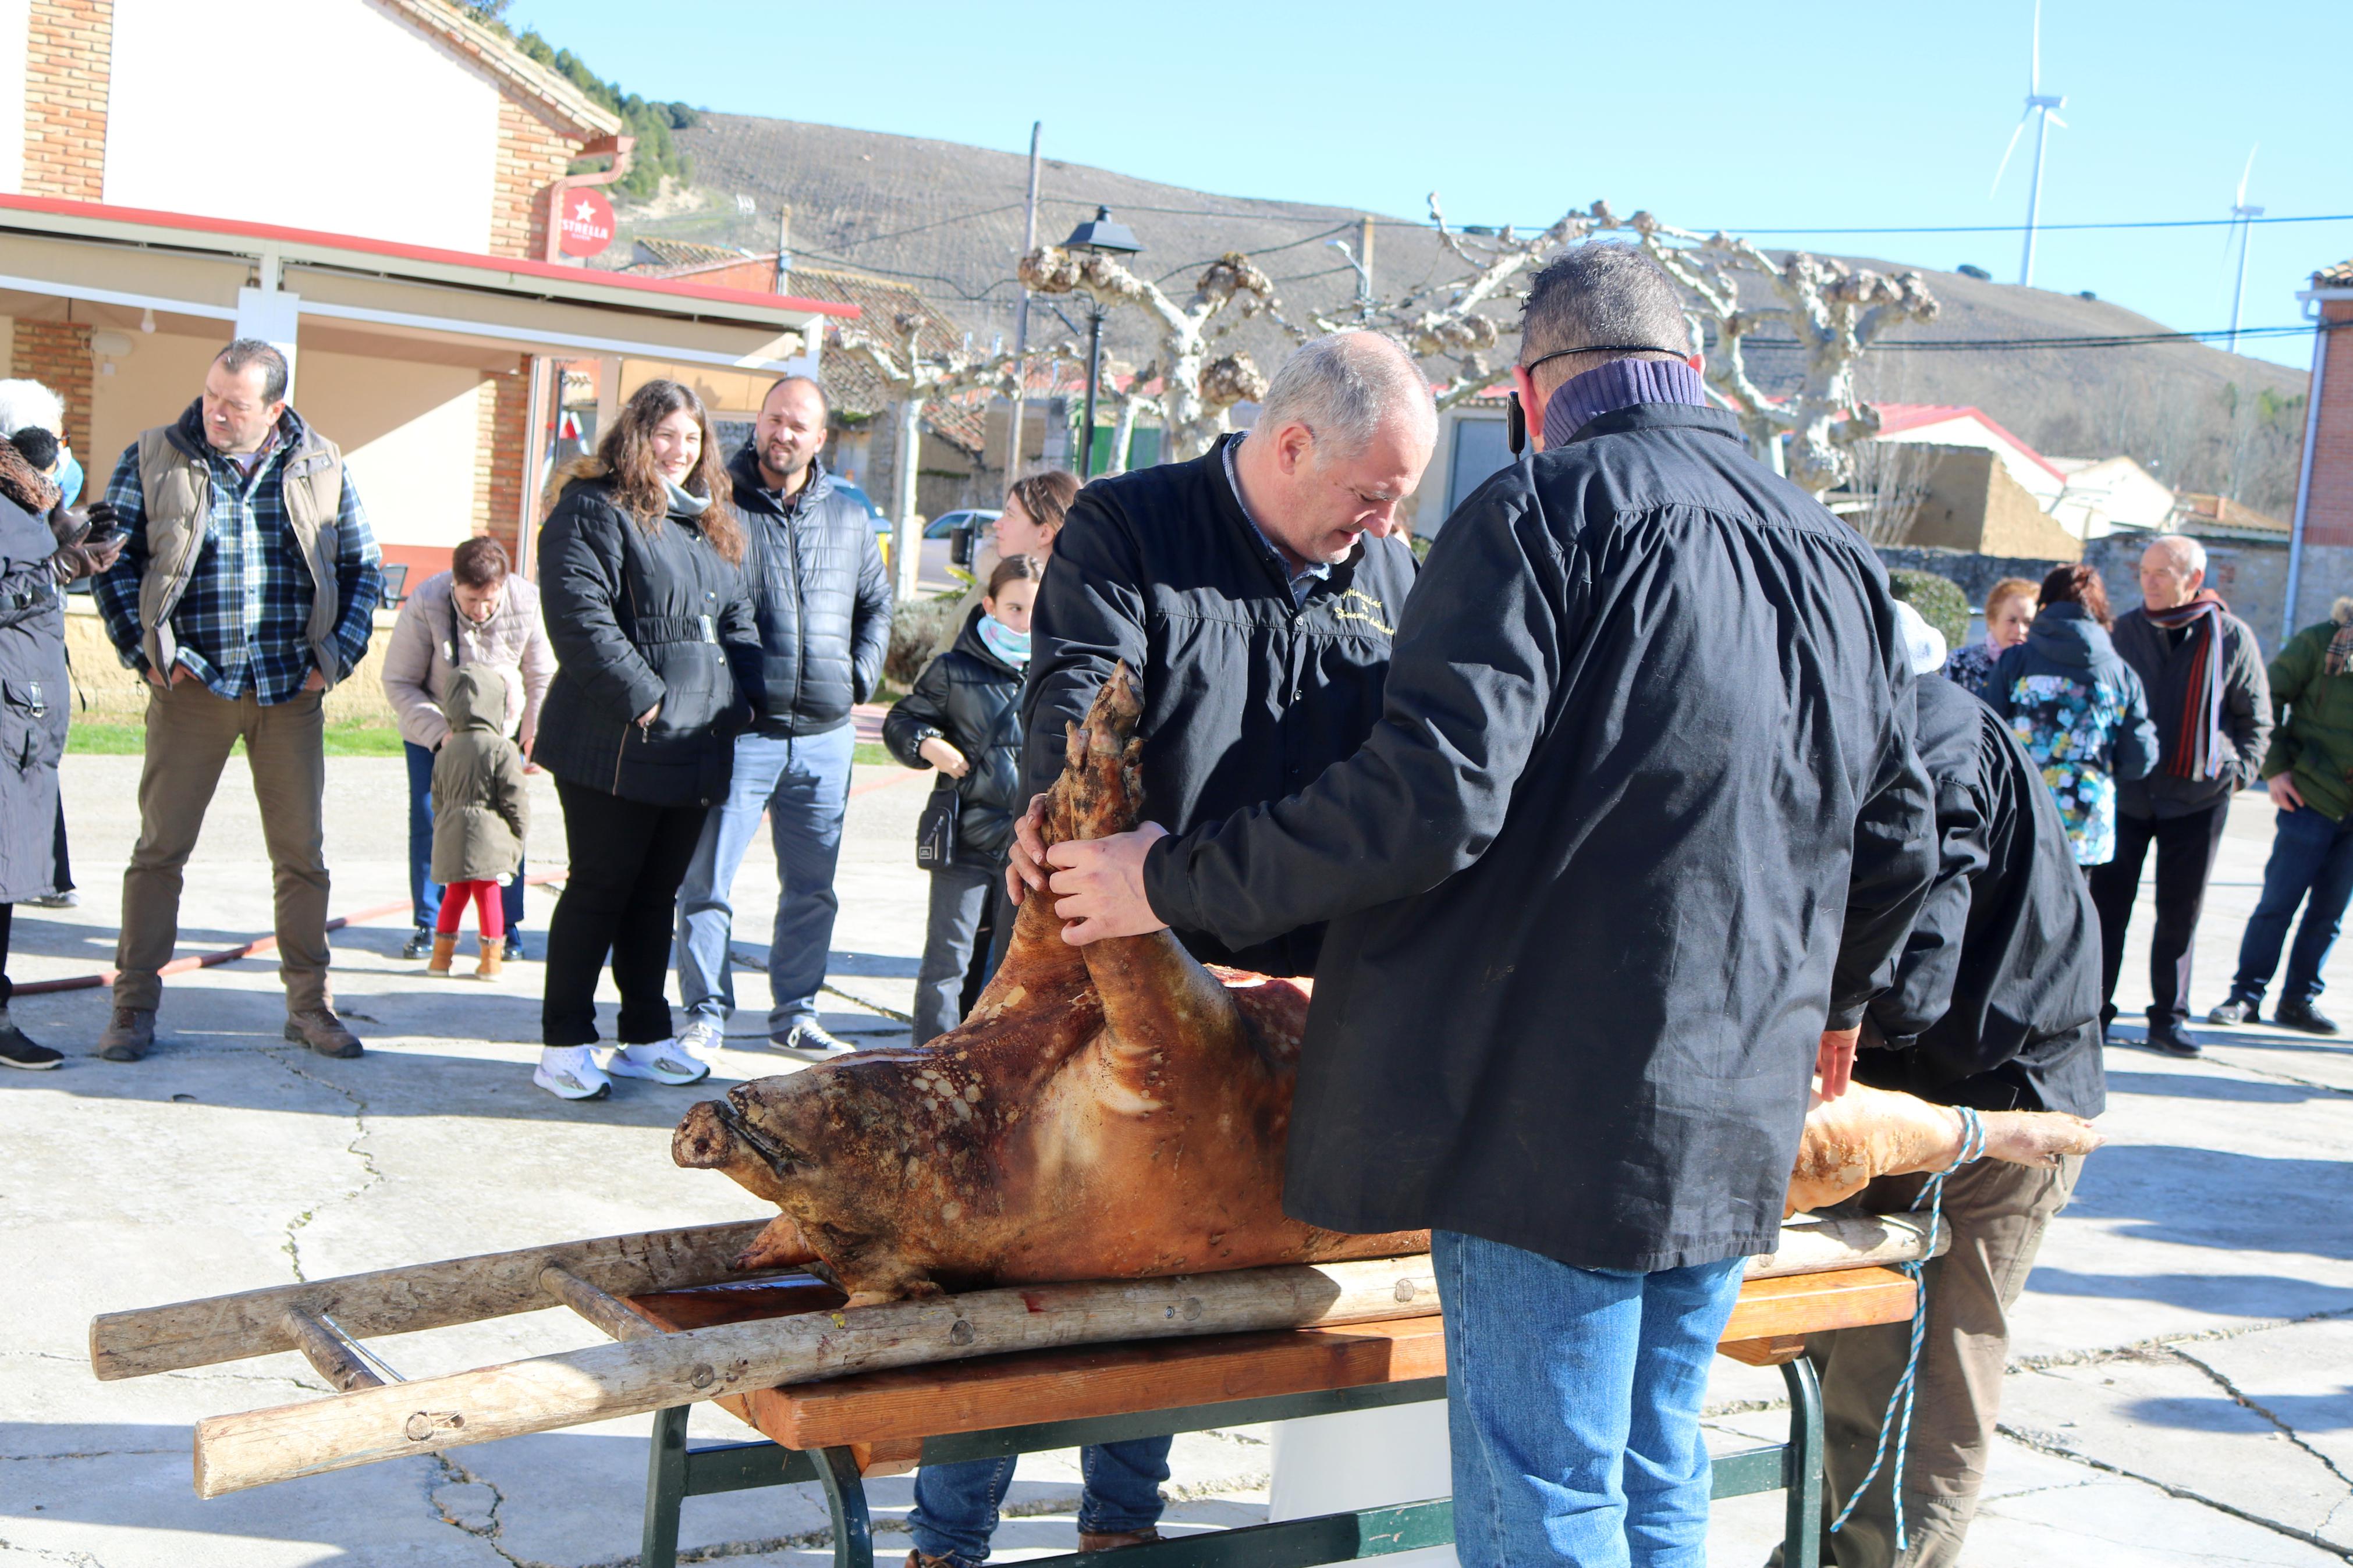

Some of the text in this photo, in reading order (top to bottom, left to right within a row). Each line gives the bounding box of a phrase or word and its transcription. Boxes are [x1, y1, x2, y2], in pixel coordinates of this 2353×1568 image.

[560, 219, 609, 240] STRELLA
[1334, 607, 1368, 621] Fuente
[1361, 601, 1369, 613] de
